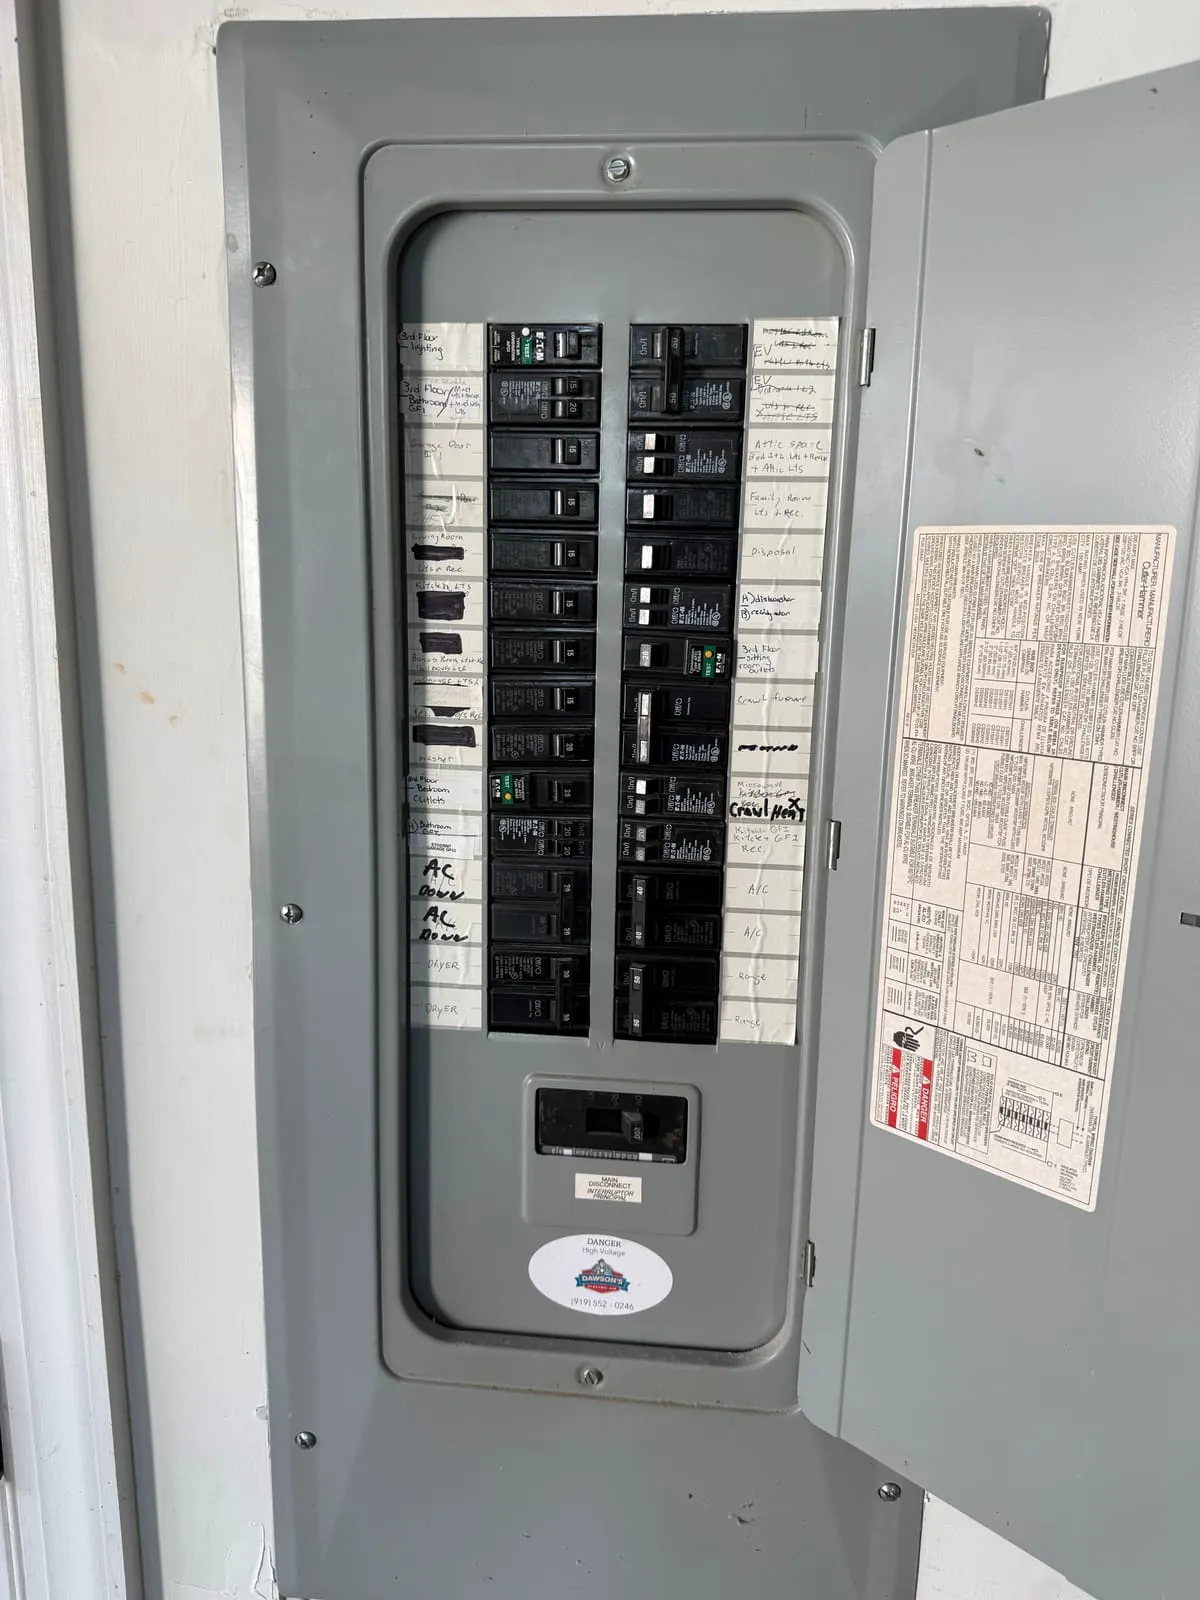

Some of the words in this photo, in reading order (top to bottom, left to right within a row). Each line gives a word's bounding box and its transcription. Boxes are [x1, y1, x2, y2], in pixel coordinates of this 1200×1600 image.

[754, 375, 772, 385] EV
[670, 392, 677, 404] 50
[570, 402, 576, 412] 20
[568, 446, 576, 454] 15
[568, 498, 576, 506] 15
[568, 550, 576, 558] 15
[1136, 561, 1151, 619] Cutler-Hammer
[566, 600, 574, 608] 15
[566, 649, 574, 657] 15
[742, 645, 758, 654] 3rd
[642, 650, 649, 660] 20
[566, 697, 574, 705] 15
[1119, 781, 1127, 811] DISCONNECT
[730, 798, 768, 818] Crawl
[564, 827, 571, 837] 20
[564, 846, 571, 856] 20
[423, 858, 455, 880] AC
[637, 886, 644, 896] 40
[748, 884, 769, 895] A/C
[423, 906, 456, 928] AC
[635, 931, 642, 939] 40
[744, 927, 761, 940] A/C
[889, 1075, 898, 1113] PELIGRO
[919, 1086, 929, 1123] DANGER
[588, 1181, 631, 1189] DISCONNECT
[587, 1188, 634, 1197] INTERRUPTOR
[593, 1193, 627, 1201] PRINCIPAL
[587, 1238, 622, 1248] DANGER
[582, 1247, 598, 1255] High
[600, 1248, 626, 1257] Voltage
[581, 1274, 623, 1285] DAWSON'S
[571, 1298, 592, 1307] (919)
[592, 1299, 607, 1308] 552
[614, 1301, 634, 1310] 0246
